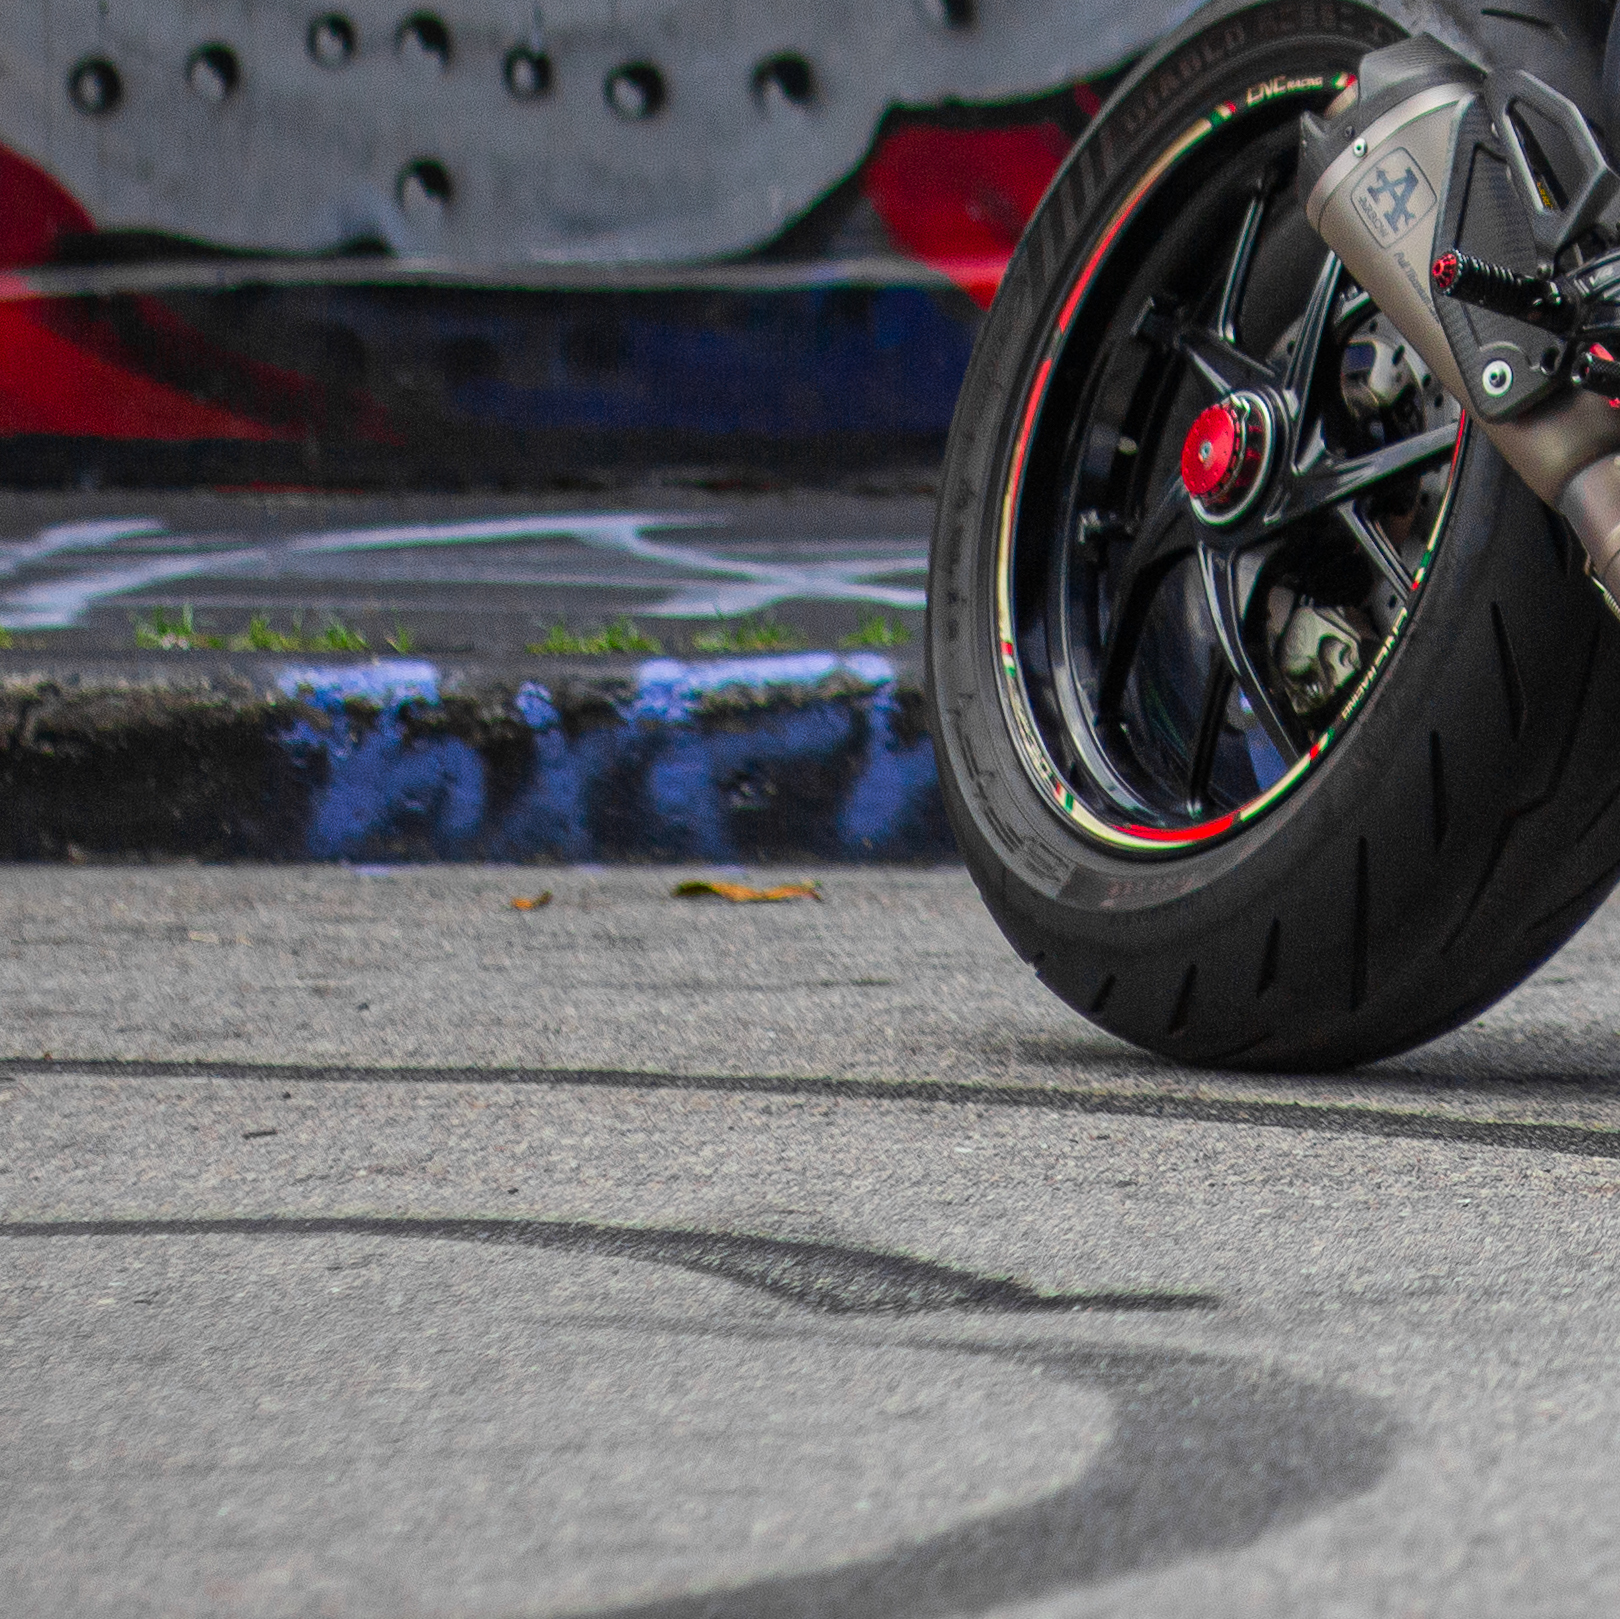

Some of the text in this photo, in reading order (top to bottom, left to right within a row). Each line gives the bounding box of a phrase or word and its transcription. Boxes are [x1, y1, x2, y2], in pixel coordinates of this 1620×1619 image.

[1246, 75, 1324, 108] CNC RACING
[1357, 196, 1390, 239] ARROW
